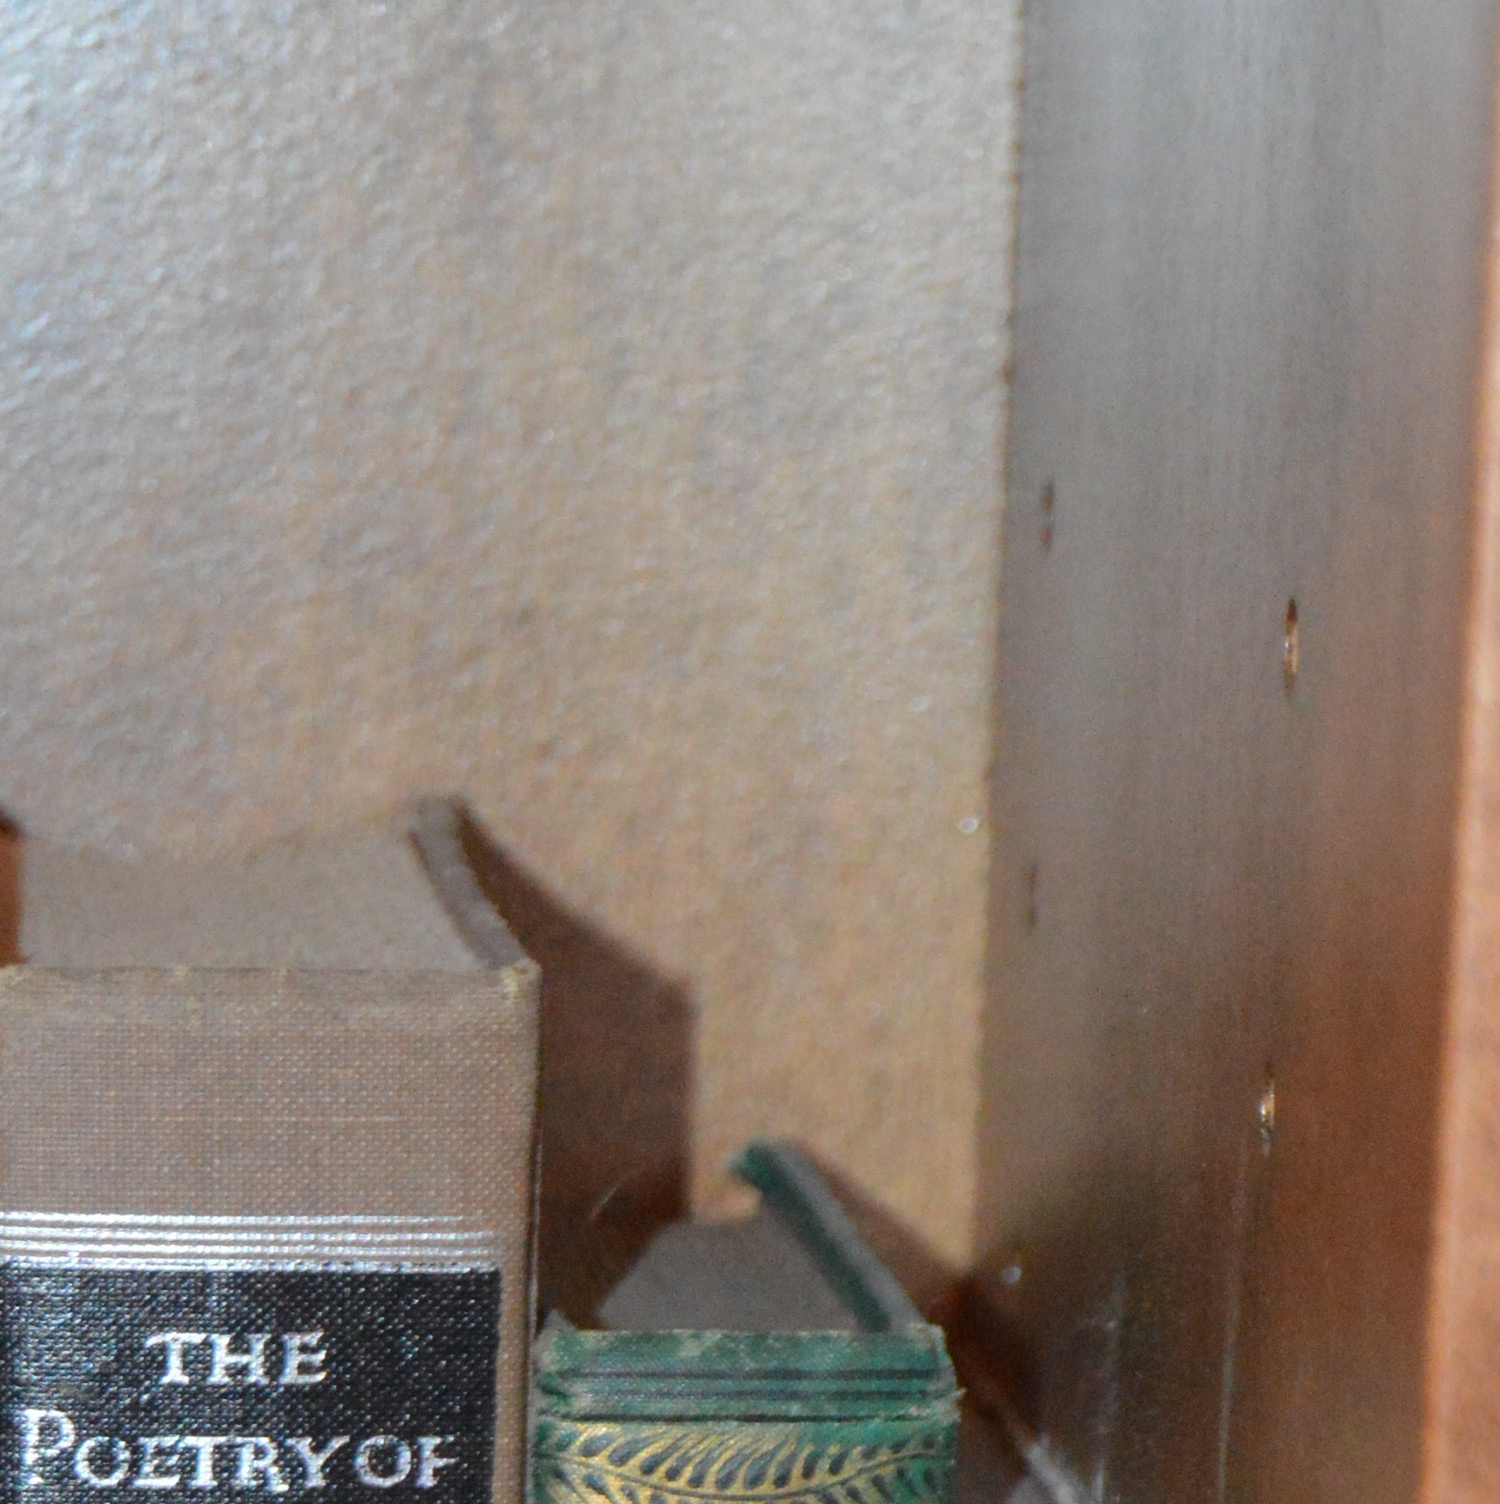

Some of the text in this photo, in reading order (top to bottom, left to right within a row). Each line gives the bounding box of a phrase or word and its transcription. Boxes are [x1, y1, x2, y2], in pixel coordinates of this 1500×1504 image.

[145, 1331, 328, 1385] THE
[13, 1408, 461, 1493] POETRY OF
